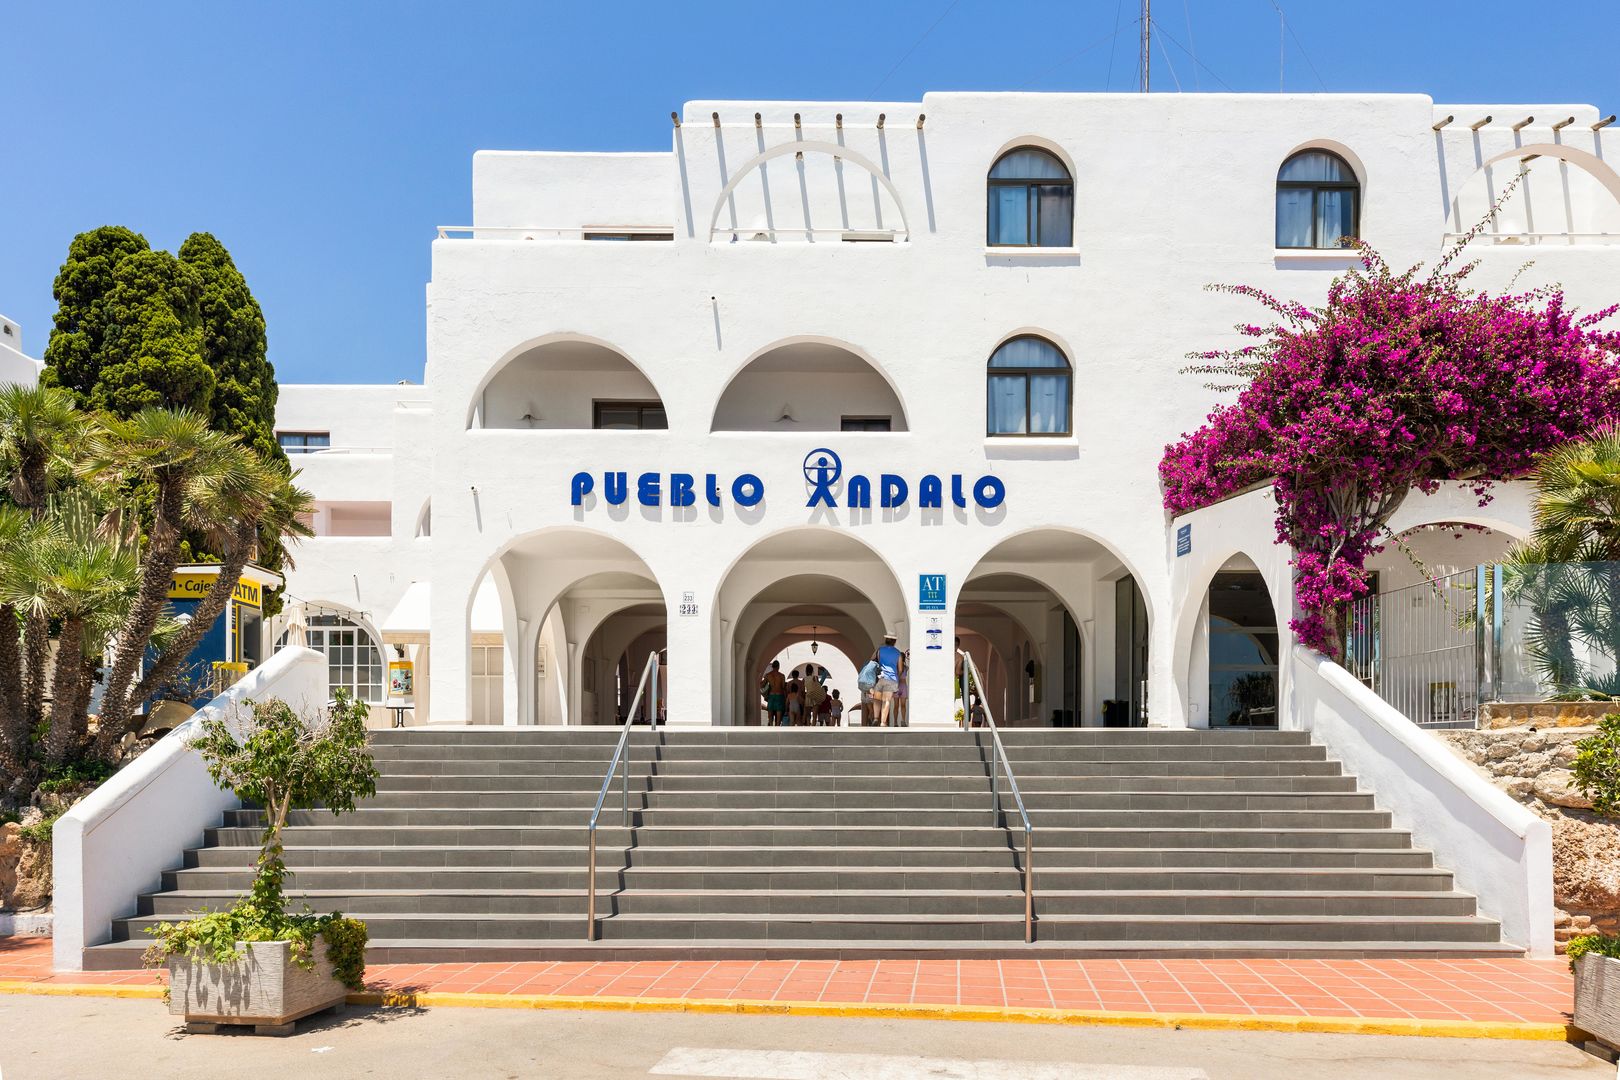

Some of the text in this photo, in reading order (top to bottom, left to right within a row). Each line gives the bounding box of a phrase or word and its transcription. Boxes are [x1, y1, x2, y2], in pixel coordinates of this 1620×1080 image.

[571, 471, 765, 508] PUEBLO
[184, 580, 214, 594] Caje
[922, 576, 943, 591] AT
[234, 583, 258, 603] ATM
